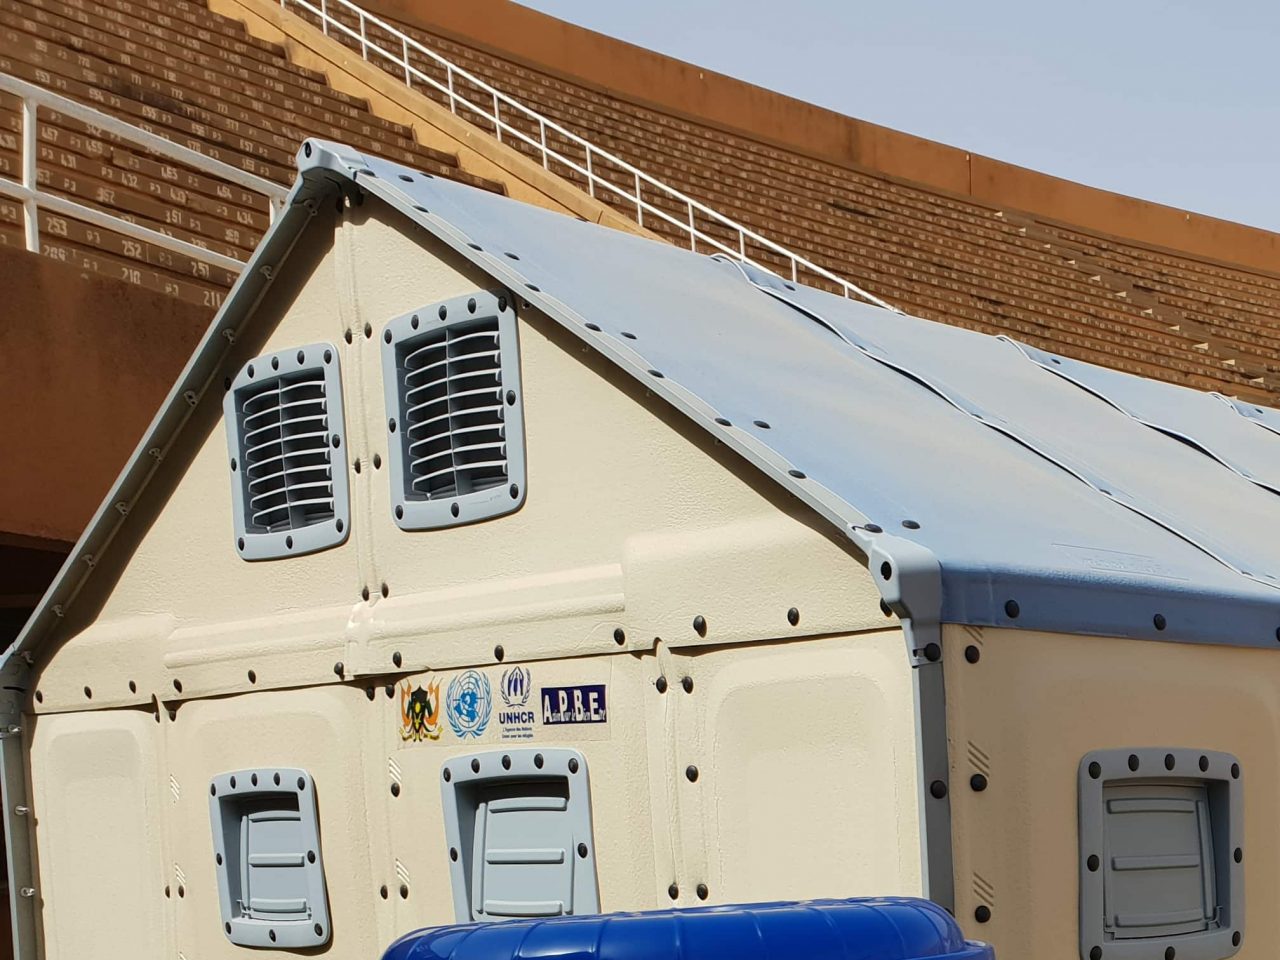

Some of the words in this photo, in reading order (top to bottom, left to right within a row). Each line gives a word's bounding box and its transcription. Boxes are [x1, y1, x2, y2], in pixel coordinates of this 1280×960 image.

[46, 217, 67, 236] 253
[121, 240, 141, 258] 252
[499, 711, 535, 724] UNHCR
